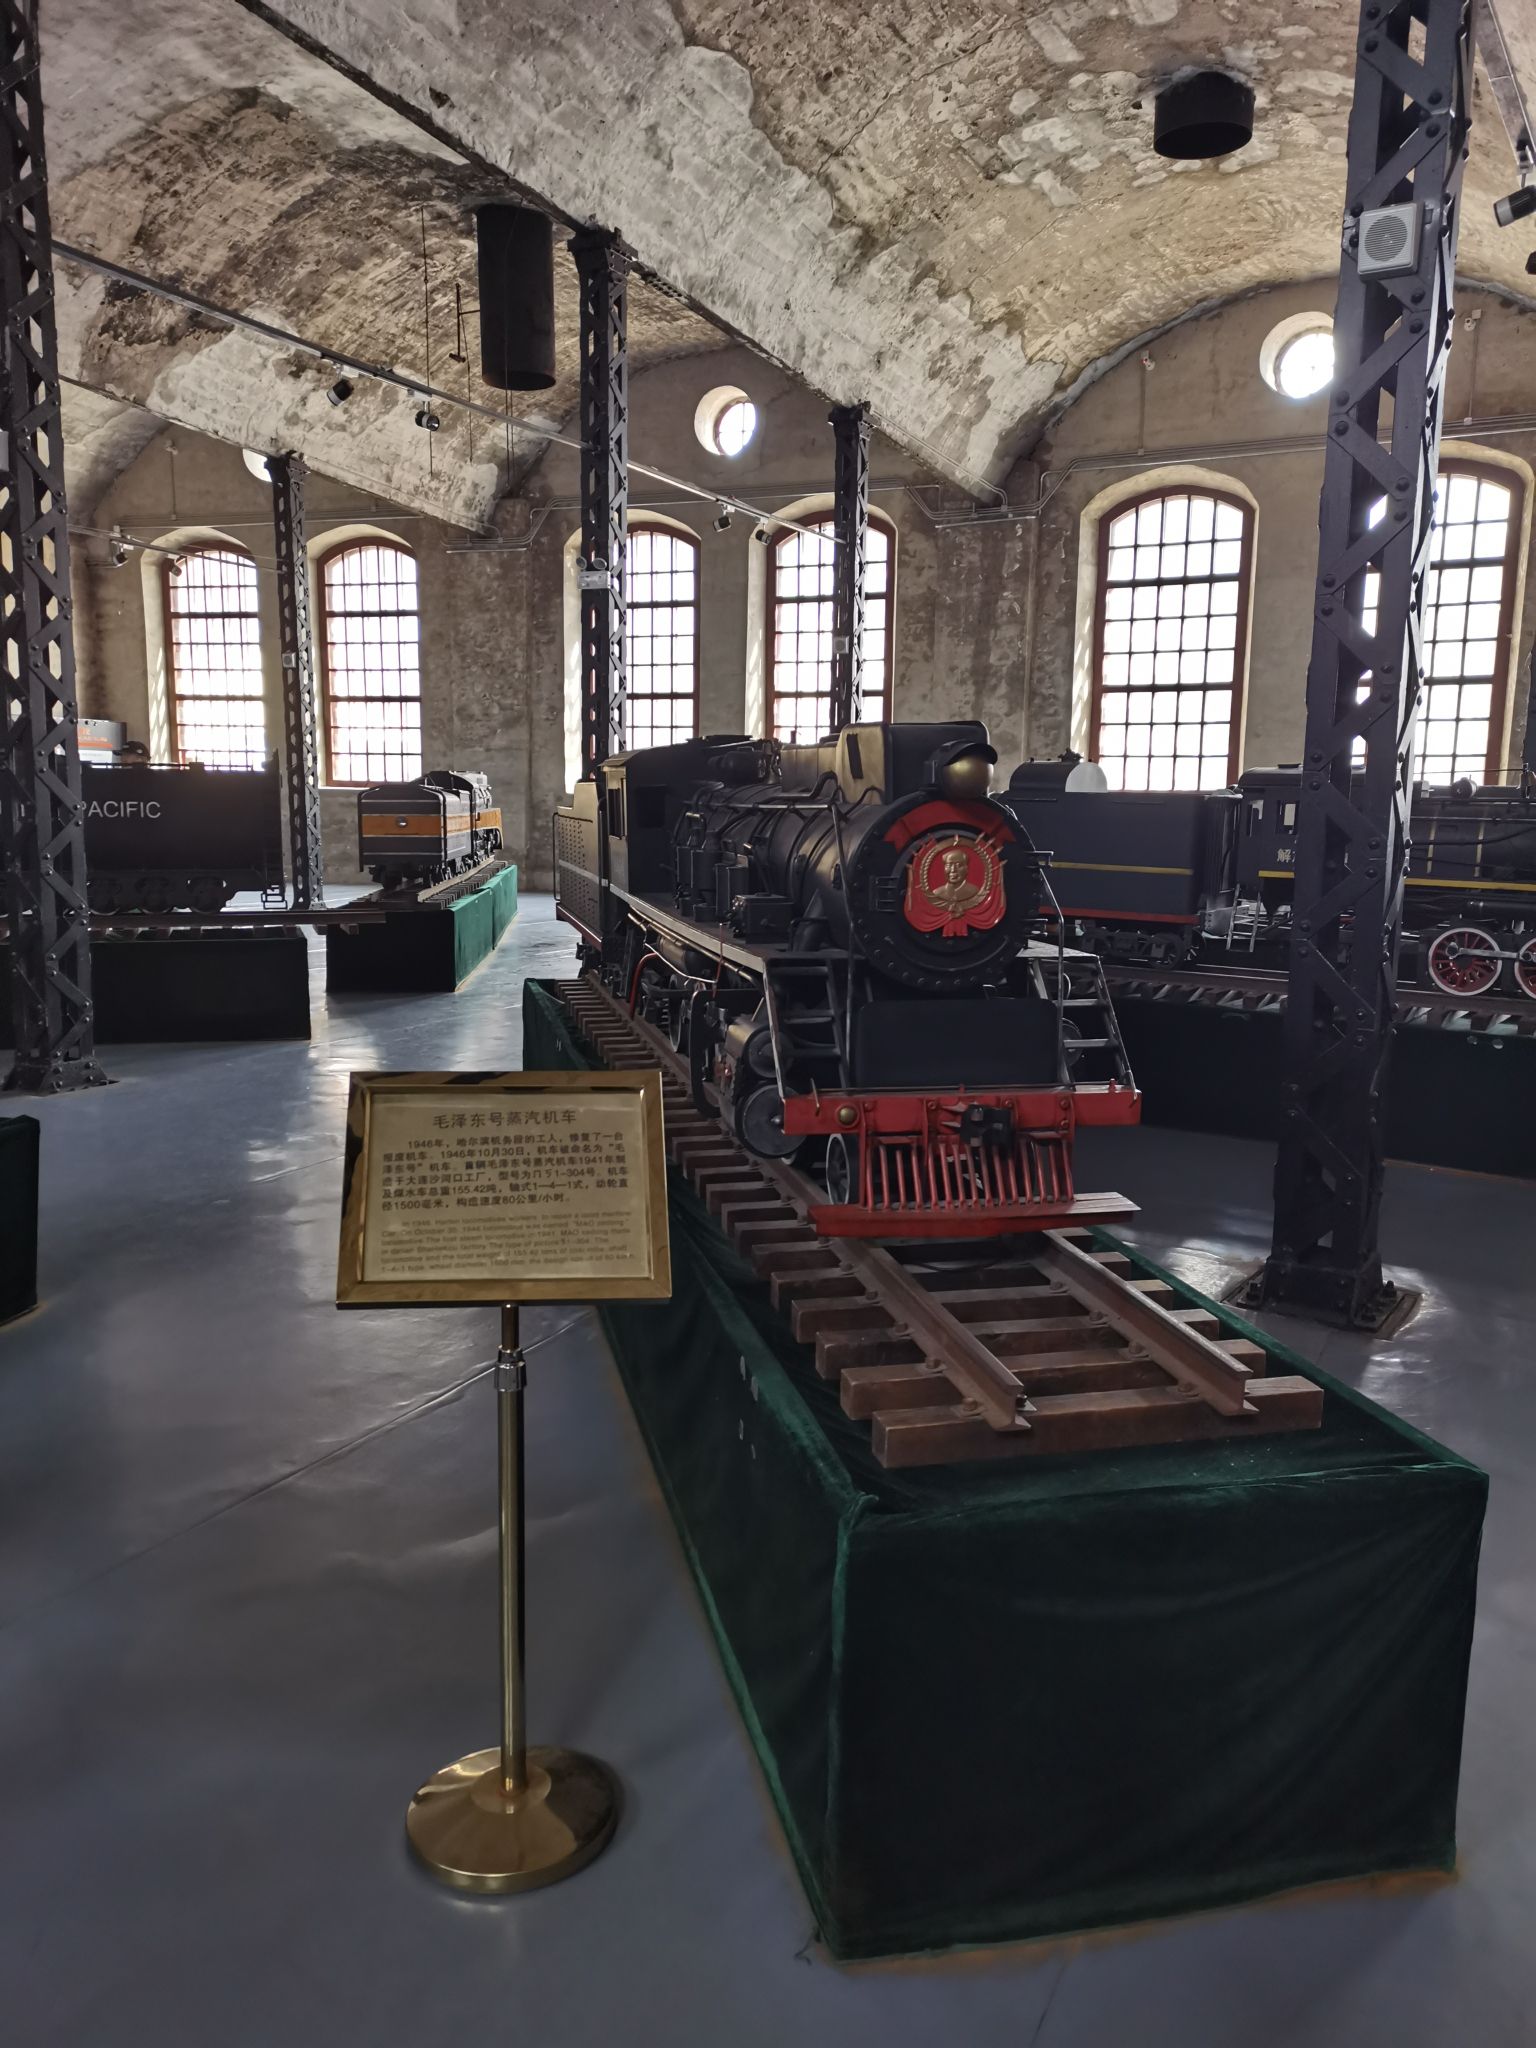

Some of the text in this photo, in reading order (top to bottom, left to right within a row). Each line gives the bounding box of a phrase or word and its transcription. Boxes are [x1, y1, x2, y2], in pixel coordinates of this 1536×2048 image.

[433, 1109, 578, 1129] 毛泽东号蒸汽机车
